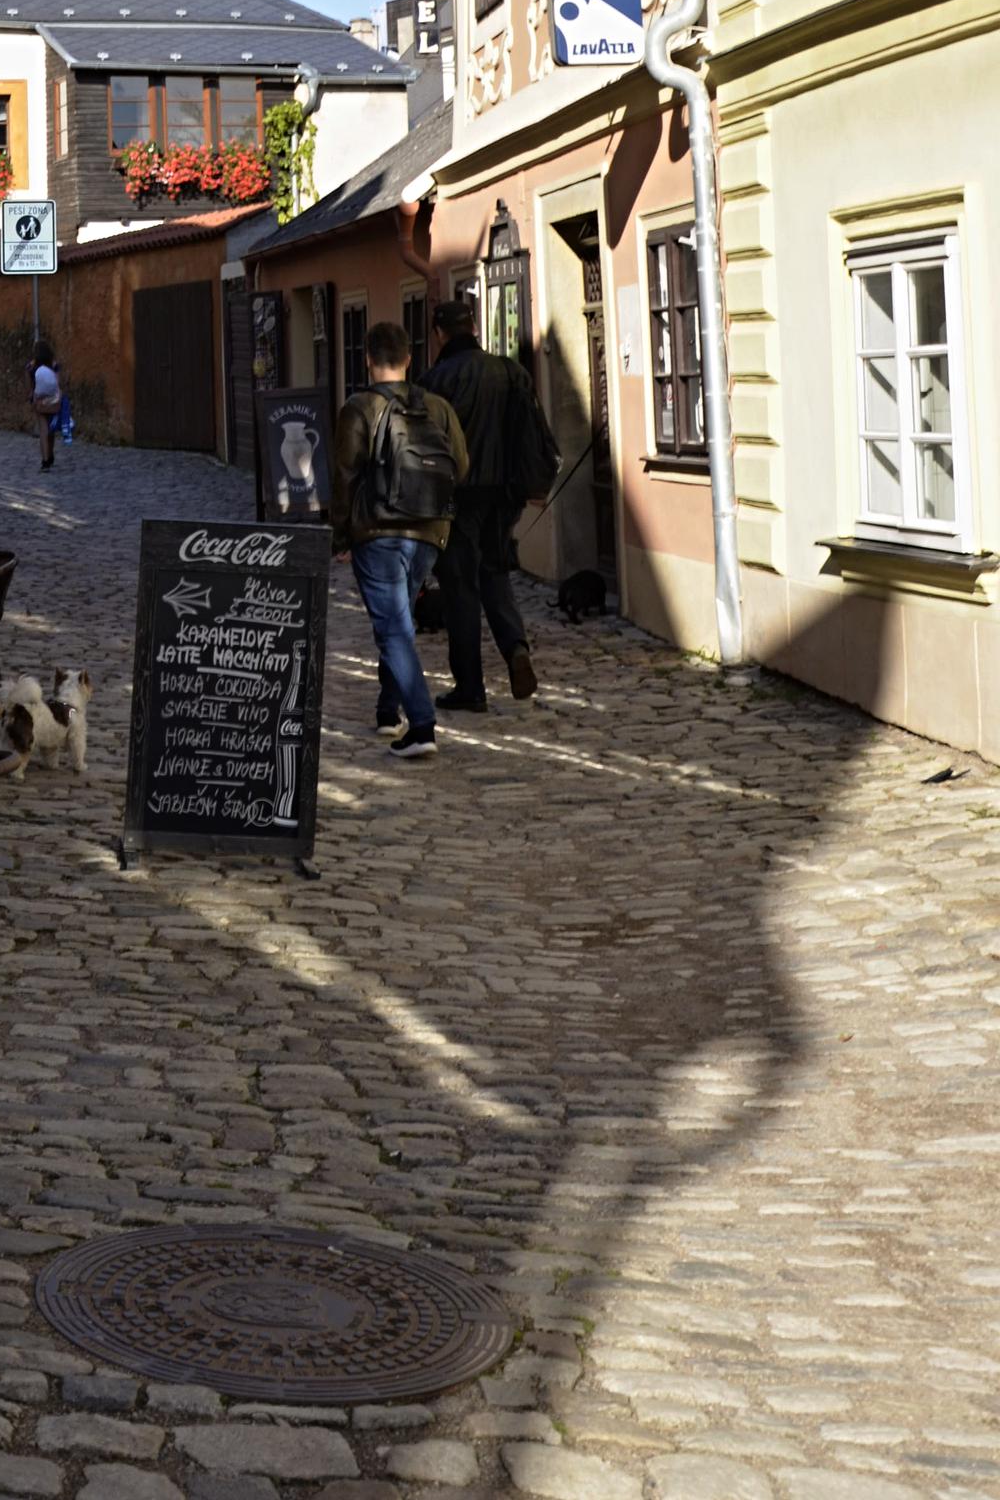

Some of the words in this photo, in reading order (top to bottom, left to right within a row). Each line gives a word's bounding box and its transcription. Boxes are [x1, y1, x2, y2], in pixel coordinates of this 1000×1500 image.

[573, 38, 635, 55] LAVAZZA
[268, 403, 317, 424] KERAMIKA
[176, 621, 284, 649] KARAMELOVÉ
[159, 671, 210, 694] HORKÁ
[164, 725, 216, 749] HORKÁ
[219, 725, 273, 754] HRUŠKA
[153, 748, 212, 779] LÍVANCE
[147, 784, 219, 817] JABLEČNÝ
